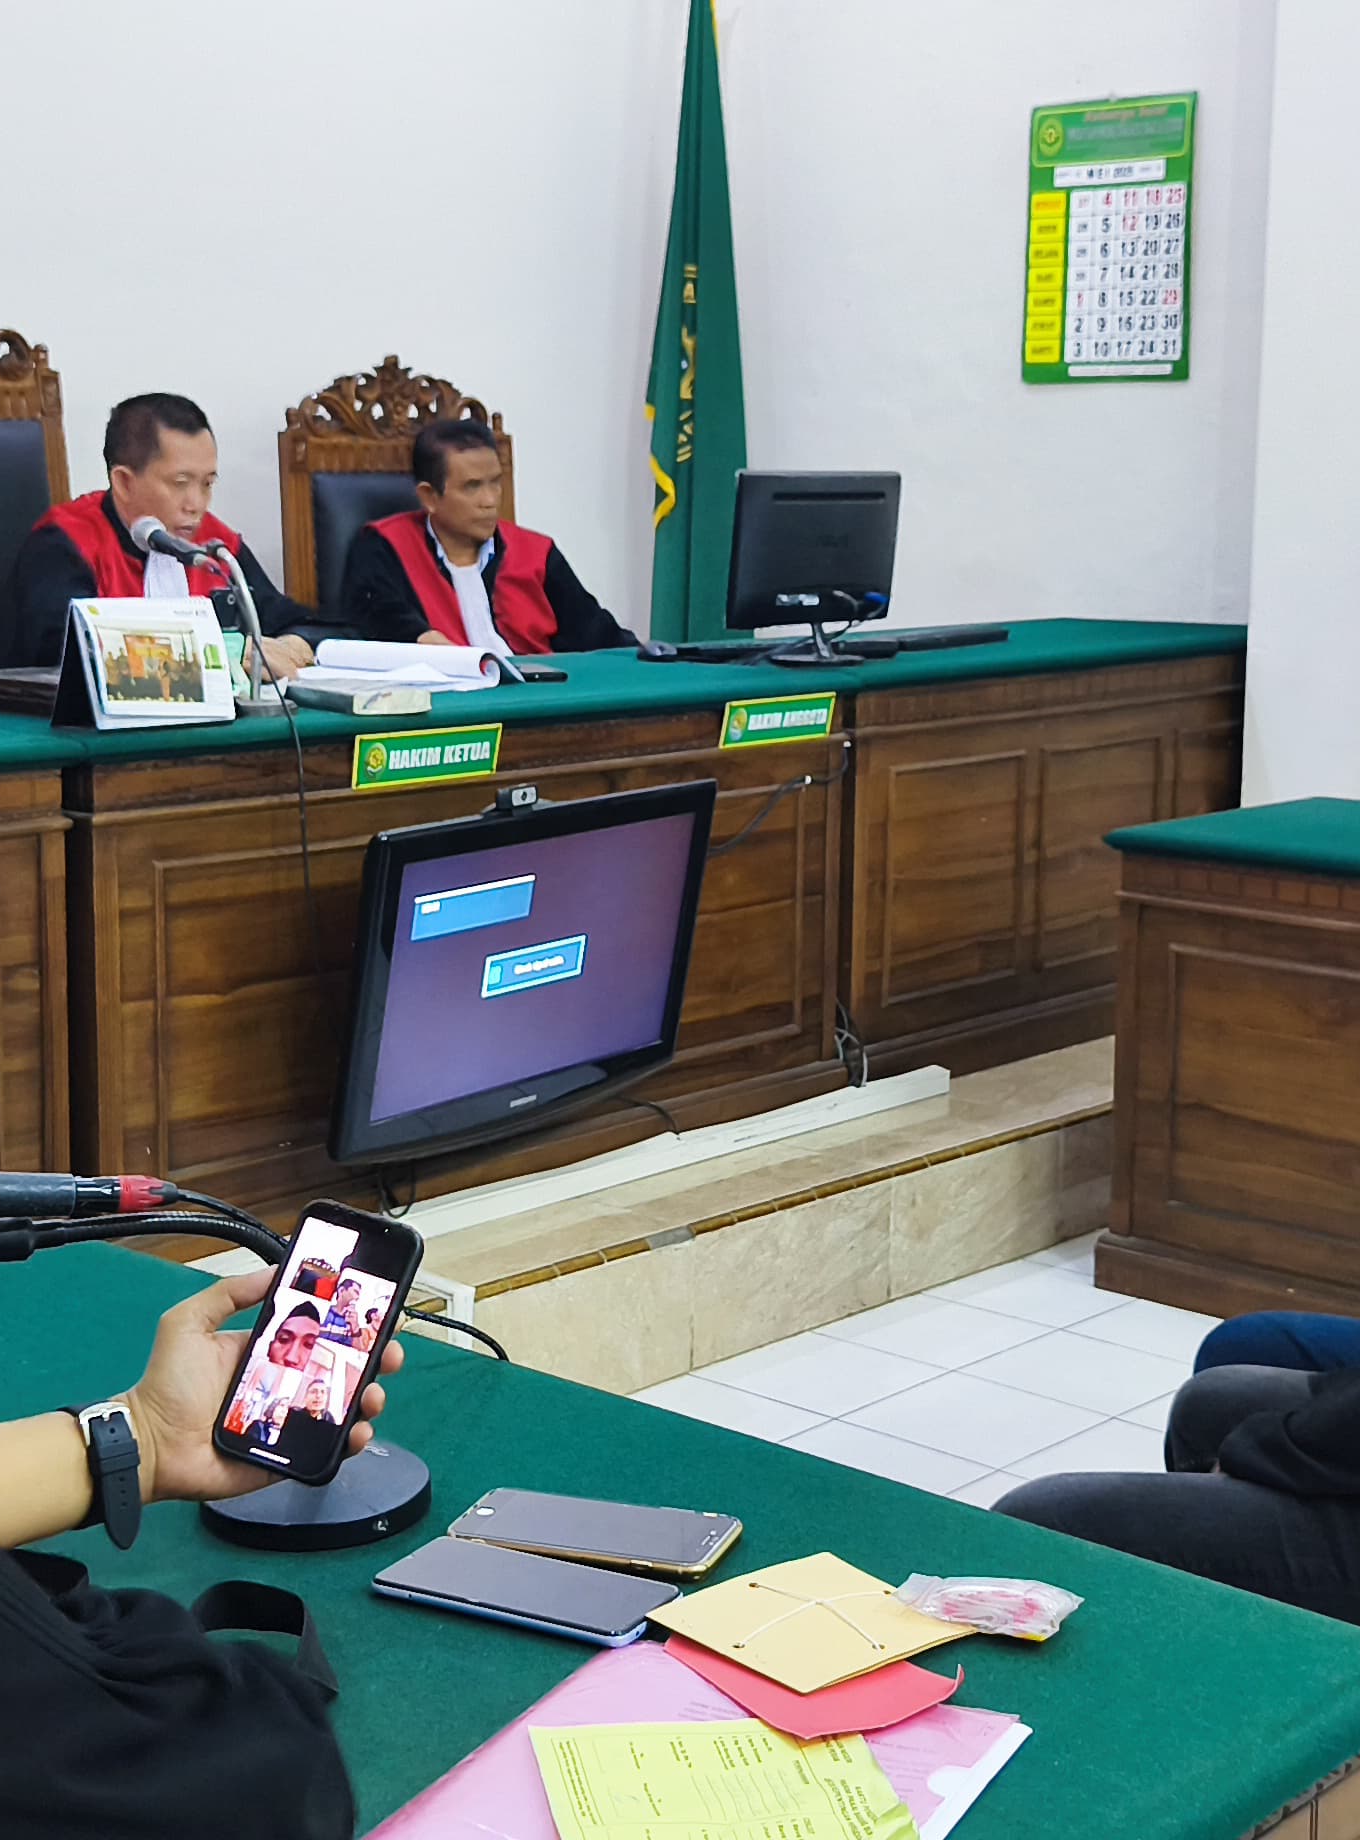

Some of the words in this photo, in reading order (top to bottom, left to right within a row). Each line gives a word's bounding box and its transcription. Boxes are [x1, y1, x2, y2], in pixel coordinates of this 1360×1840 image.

[1104, 192, 1112, 207] 4
[1124, 191, 1136, 206] 11
[1167, 188, 1184, 204] 25
[1101, 217, 1110, 233] 5
[1122, 215, 1137, 231] 12
[1145, 214, 1160, 230] 19
[1165, 212, 1181, 229] 26
[1100, 242, 1109, 258] 6
[1121, 241, 1136, 257] 13
[1143, 240, 1158, 256] 20
[1165, 238, 1180, 255] 27
[1100, 267, 1108, 281] 7
[1120, 265, 1134, 280] 14
[1142, 264, 1157, 280] 21
[1164, 263, 1179, 279] 28
[1098, 292, 1107, 307] 8
[1119, 291, 1134, 306] 15
[1141, 290, 1156, 305] 22
[1162, 289, 1177, 305] 29
[1074, 317, 1082, 333] 2
[1097, 317, 1106, 332] 9
[1118, 316, 1133, 331] 16
[1140, 315, 1156, 330] 23
[1162, 314, 1178, 330] 30
[1074, 342, 1081, 357] 3
[1094, 341, 1109, 357] 10
[1117, 341, 1132, 356] 17
[1139, 340, 1154, 356] 24
[1161, 339, 1176, 355] 31
[388, 746, 441, 770] HAKIM
[443, 741, 490, 764] KETUA
